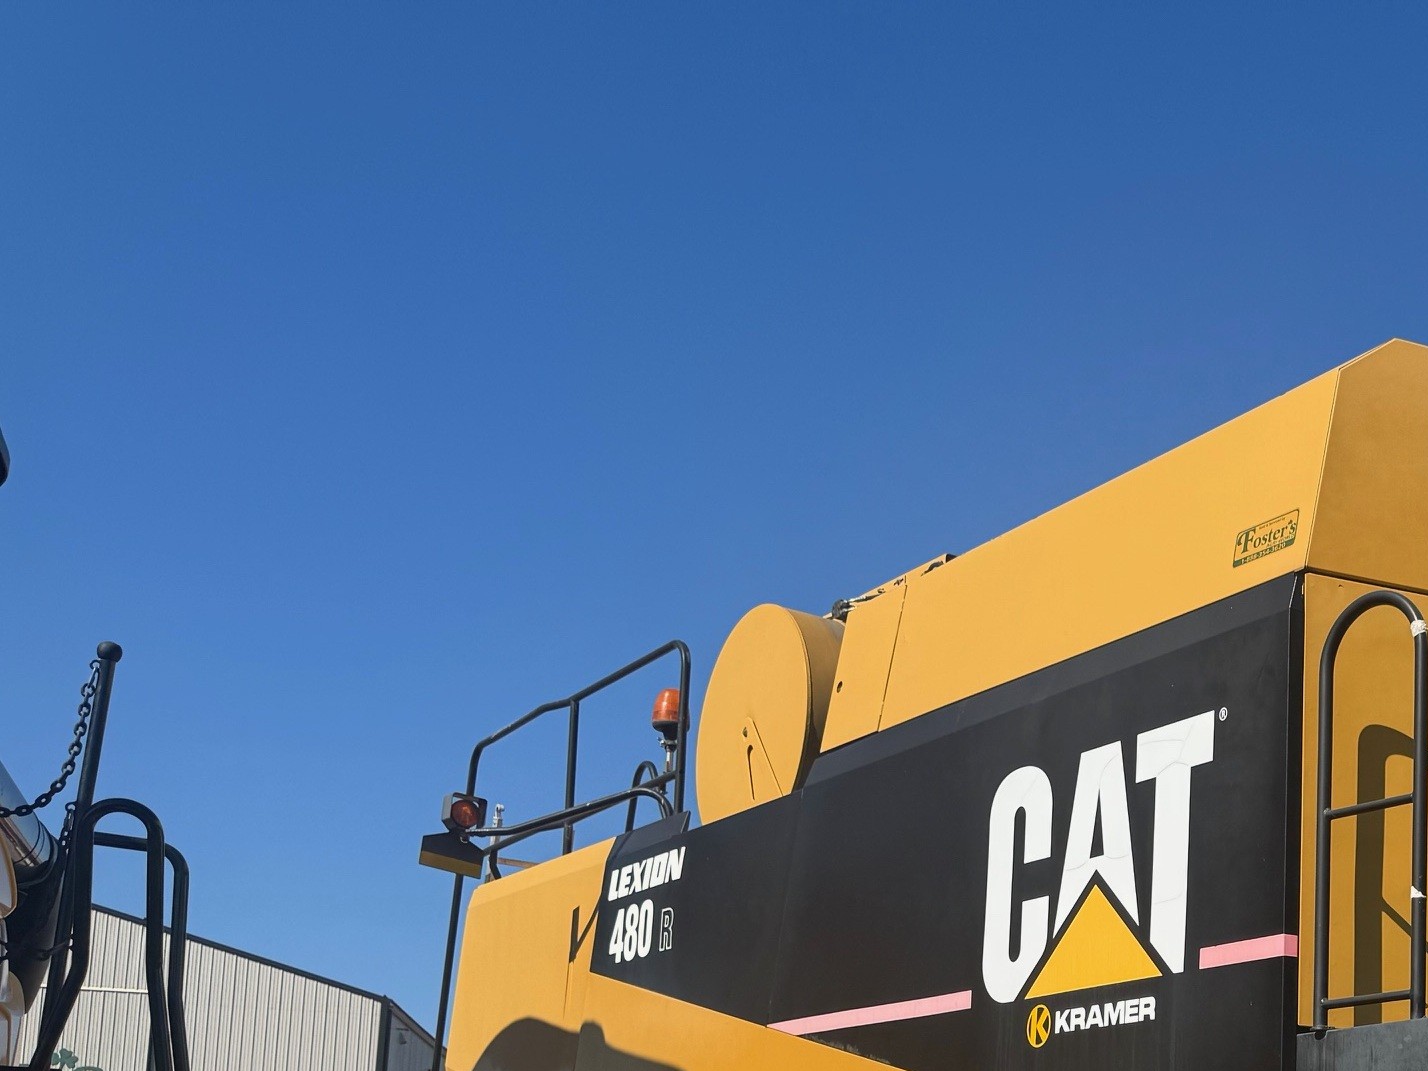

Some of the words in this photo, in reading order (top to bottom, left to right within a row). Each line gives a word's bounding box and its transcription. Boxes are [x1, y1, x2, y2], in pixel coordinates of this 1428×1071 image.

[1237, 521, 1297, 554] Foster's
[607, 846, 687, 902] LEXION
[982, 709, 1216, 1004] CAT
[608, 899, 654, 964] 480
[658, 907, 674, 952] R
[1054, 996, 1156, 1034] KRAMER
